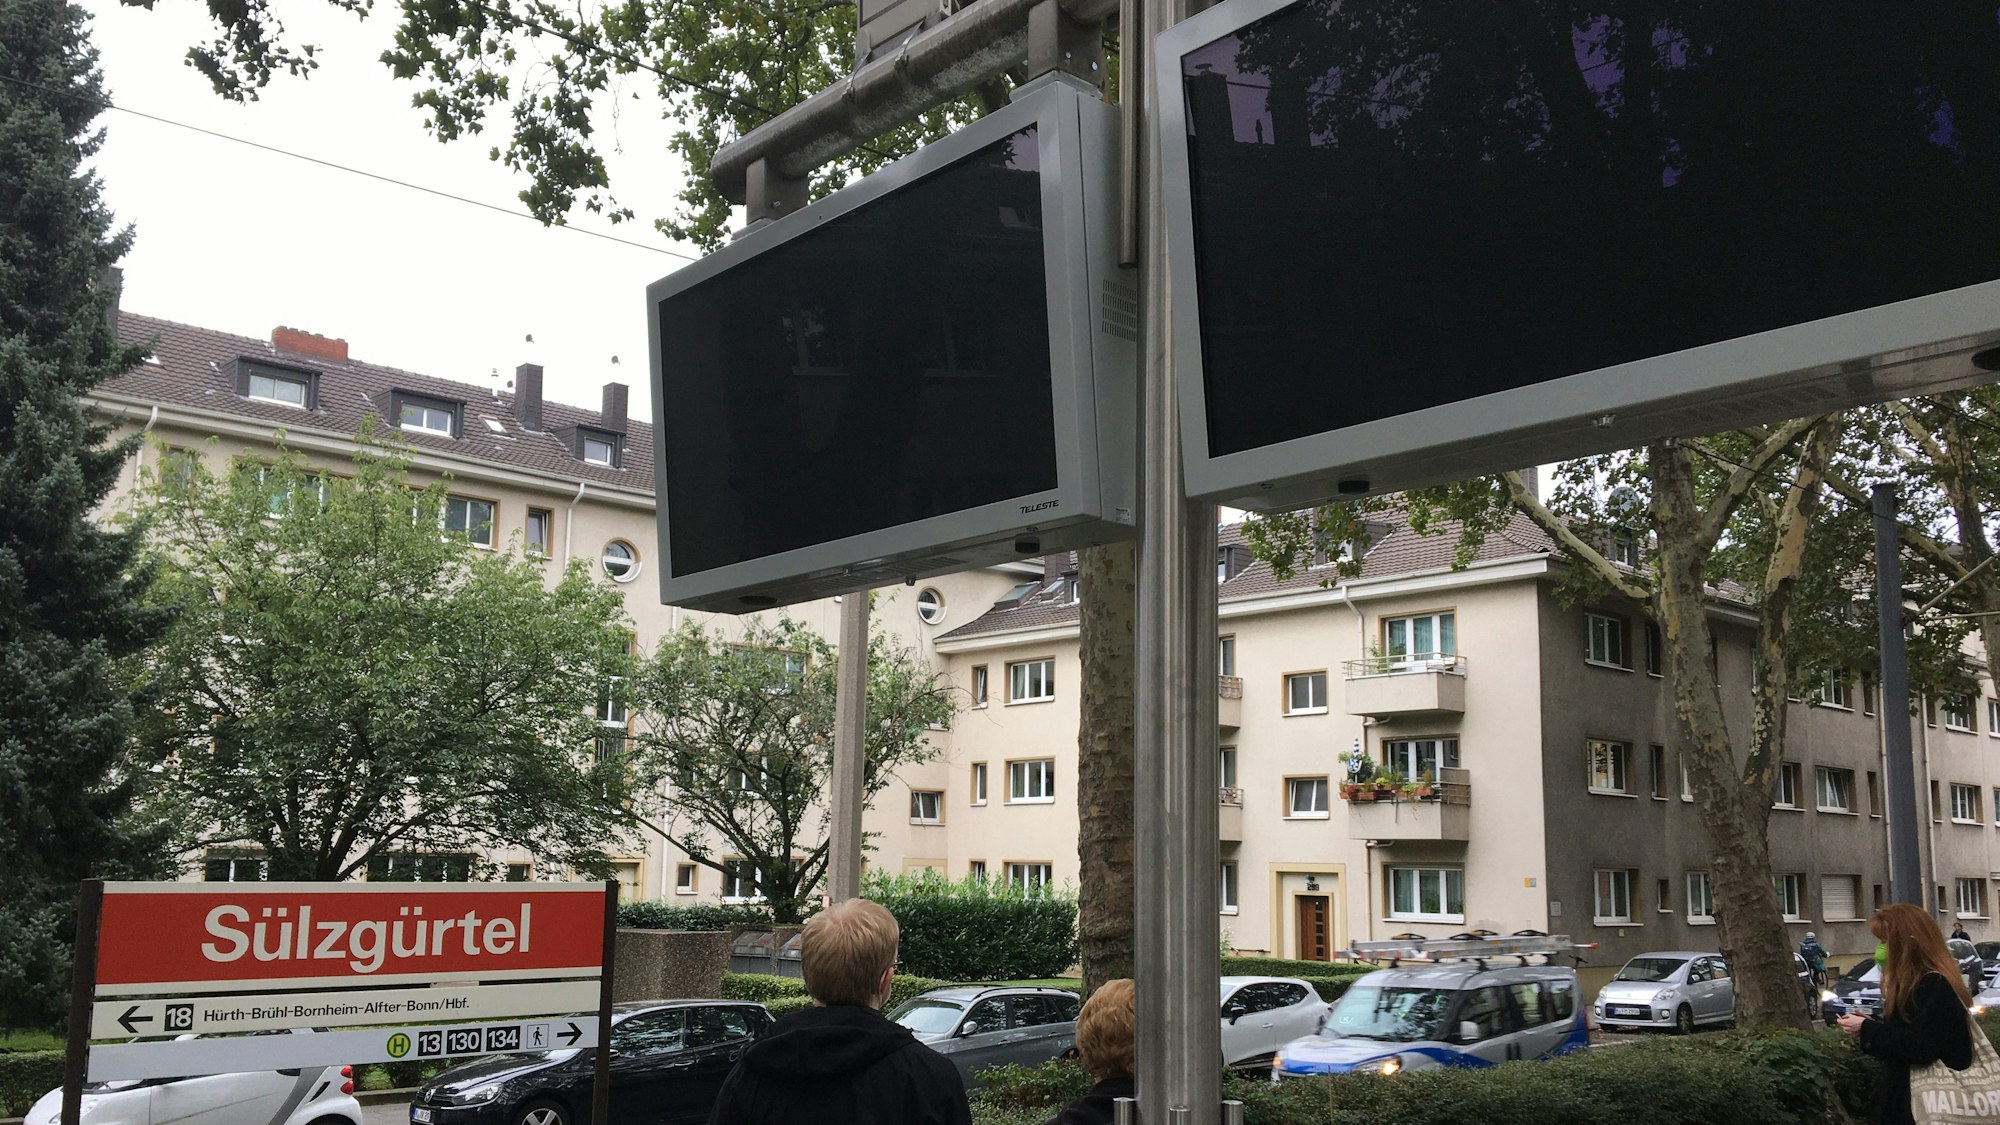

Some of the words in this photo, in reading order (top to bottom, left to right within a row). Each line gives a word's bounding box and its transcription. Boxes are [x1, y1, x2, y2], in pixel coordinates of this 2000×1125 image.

[1020, 500, 1060, 514] TELESTE
[201, 903, 531, 974] Sülzgürtel
[166, 1006, 193, 1028] 18
[203, 998, 470, 1022] Hürth-Brühl-Bornheim-Alfter-Bonn/Hbf.
[419, 1033, 441, 1053] 13
[448, 1031, 480, 1051] 130
[488, 1029, 519, 1049] 134
